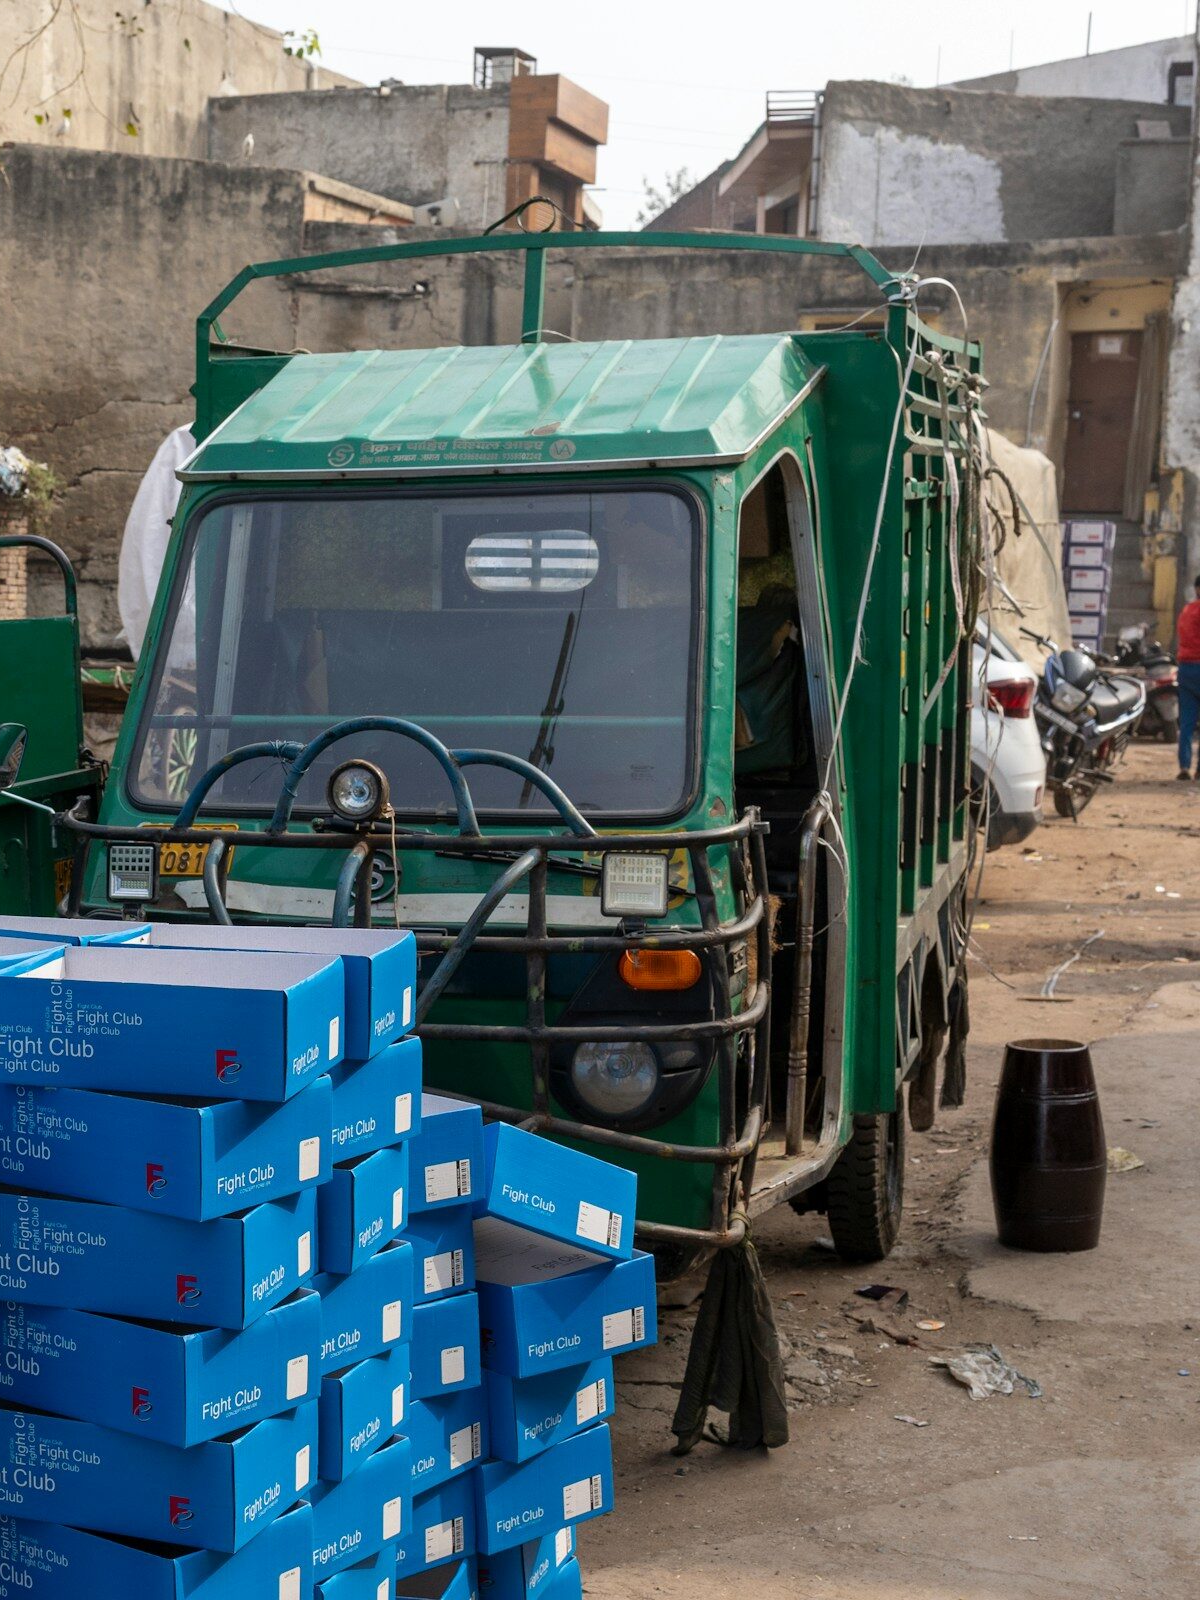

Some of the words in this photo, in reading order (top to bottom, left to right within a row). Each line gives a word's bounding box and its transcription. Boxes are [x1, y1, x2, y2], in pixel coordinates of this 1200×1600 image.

[160, 852, 203, 872] 081
[51, 1000, 65, 1034] Fight
[77, 1010, 108, 1026] Fight
[112, 1012, 142, 1026] Club
[16, 1025, 33, 1033] Club
[78, 1025, 98, 1036] Fight
[100, 1026, 120, 1036] Club
[49, 1038, 94, 1058] Club
[31, 1060, 60, 1073] Club
[331, 1125, 354, 1145] Fight
[355, 1117, 376, 1136] Club
[16, 1137, 50, 1160] Club
[217, 1172, 246, 1195] Fight
[248, 1164, 274, 1184] Club
[502, 1184, 529, 1204] Fight
[531, 1195, 556, 1213] Club
[43, 1228, 74, 1244] Fight
[77, 1231, 106, 1246] Club
[17, 1254, 60, 1276] Club
[252, 1276, 269, 1301] Fight
[269, 1265, 285, 1286] Club
[528, 1340, 554, 1357] Fight
[556, 1334, 581, 1349] Club
[5, 1351, 40, 1376] Club
[202, 1396, 232, 1420] Fight
[234, 1386, 261, 1407] Club
[13, 1469, 55, 1492] Club
[496, 1515, 520, 1532] Fight
[522, 1507, 544, 1522] Club
[312, 1542, 337, 1566] Fight
[339, 1530, 362, 1551] Club
[0, 1562, 33, 1589] Club
